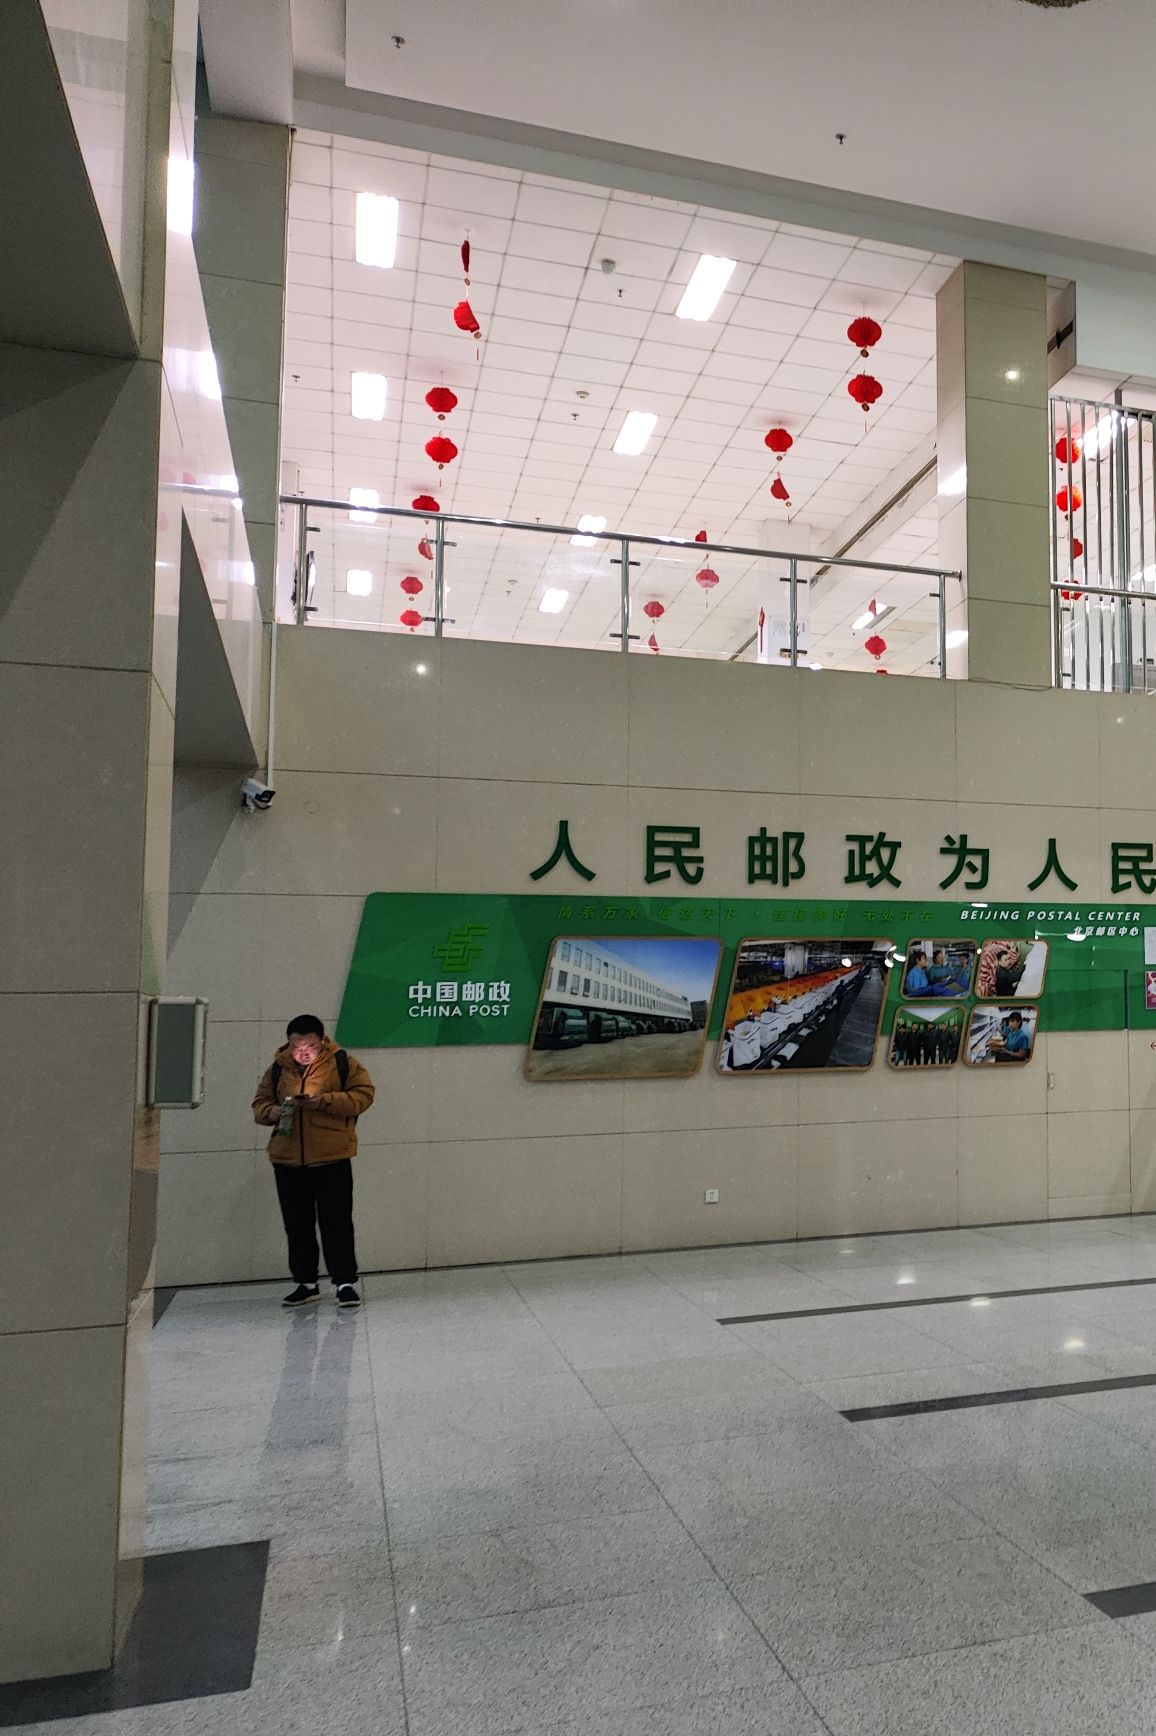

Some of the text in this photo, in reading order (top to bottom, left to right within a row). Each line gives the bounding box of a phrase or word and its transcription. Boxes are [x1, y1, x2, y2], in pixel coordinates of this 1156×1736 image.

[558, 905, 641, 920] 情系万家
[657, 906, 737, 921] 信达天下
[863, 909, 933, 922] 无处不在
[960, 910, 1141, 922] BEIJING POSTAL CENTER
[1073, 926, 1140, 937] 北京邮区中心
[408, 980, 511, 1004] 中国邮政
[408, 1004, 510, 1018] CHINA POST
